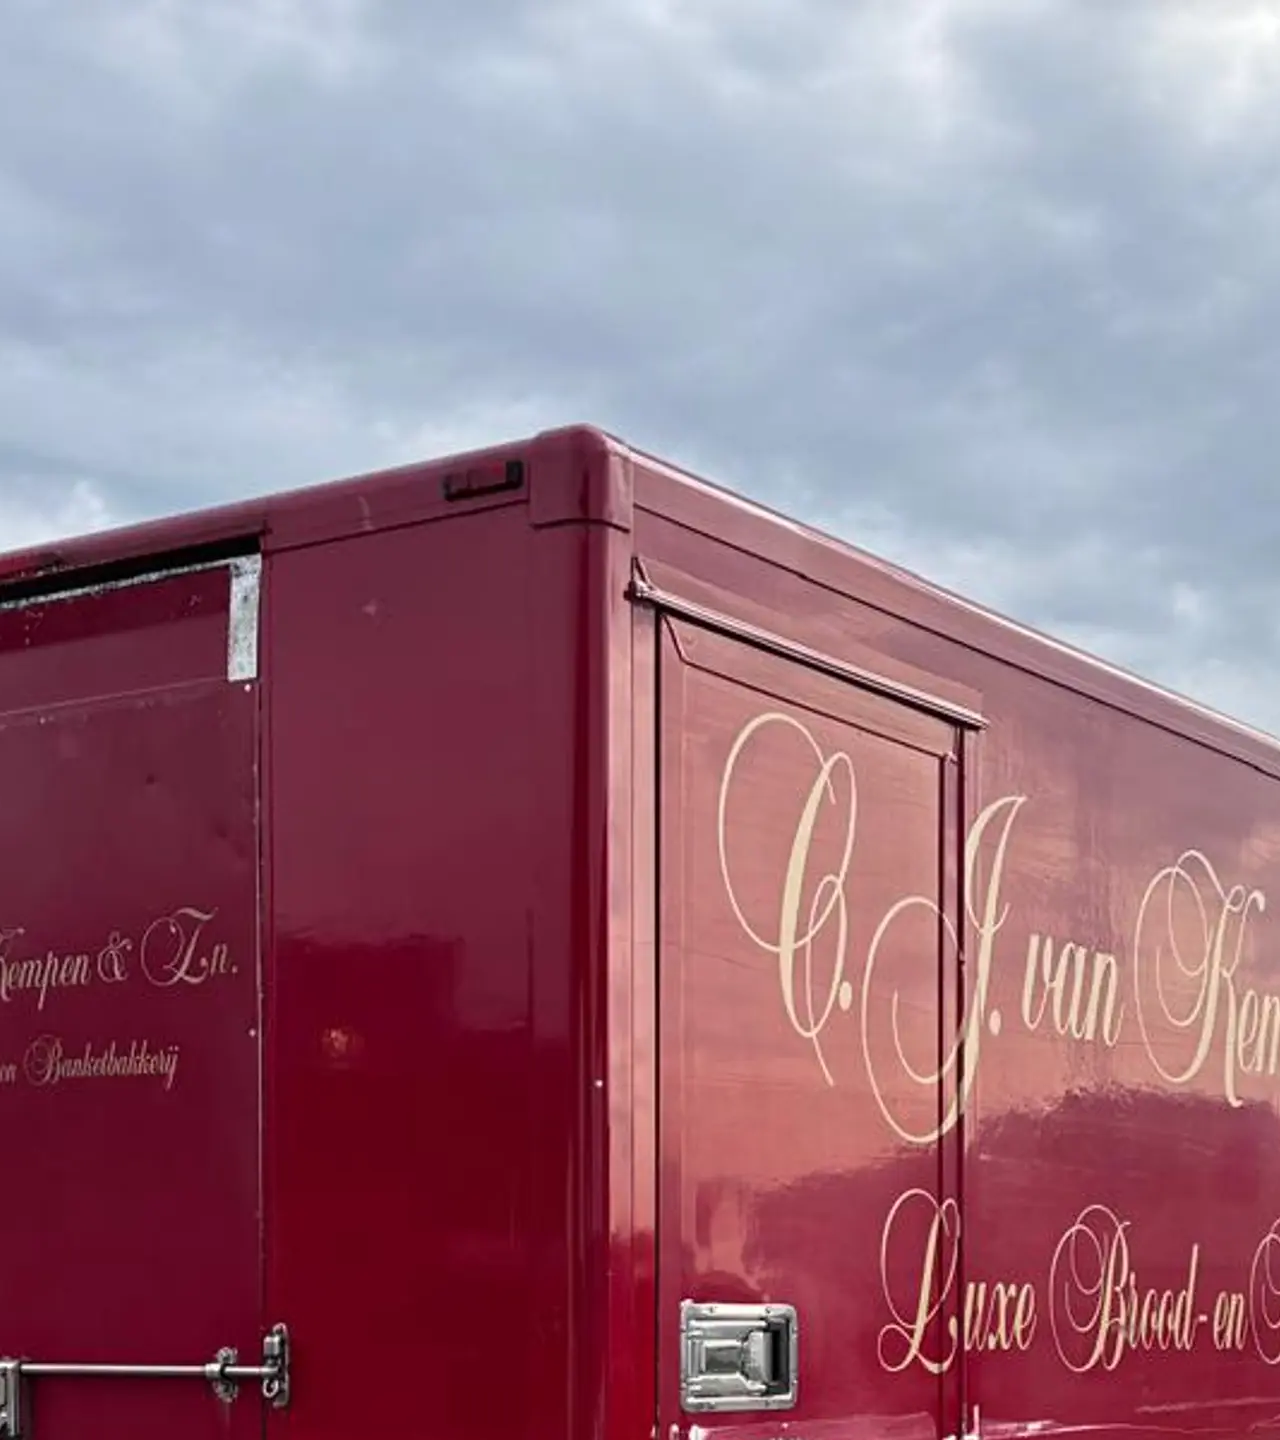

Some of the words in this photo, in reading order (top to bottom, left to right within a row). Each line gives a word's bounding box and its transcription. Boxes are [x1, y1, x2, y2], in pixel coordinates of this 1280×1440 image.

[97, 931, 132, 982] &
[141, 907, 238, 987] Zn.
[1022, 934, 1121, 1046] van
[24, 1035, 180, 1089] Banketbakkerij
[877, 1188, 1036, 1374] Luxe
